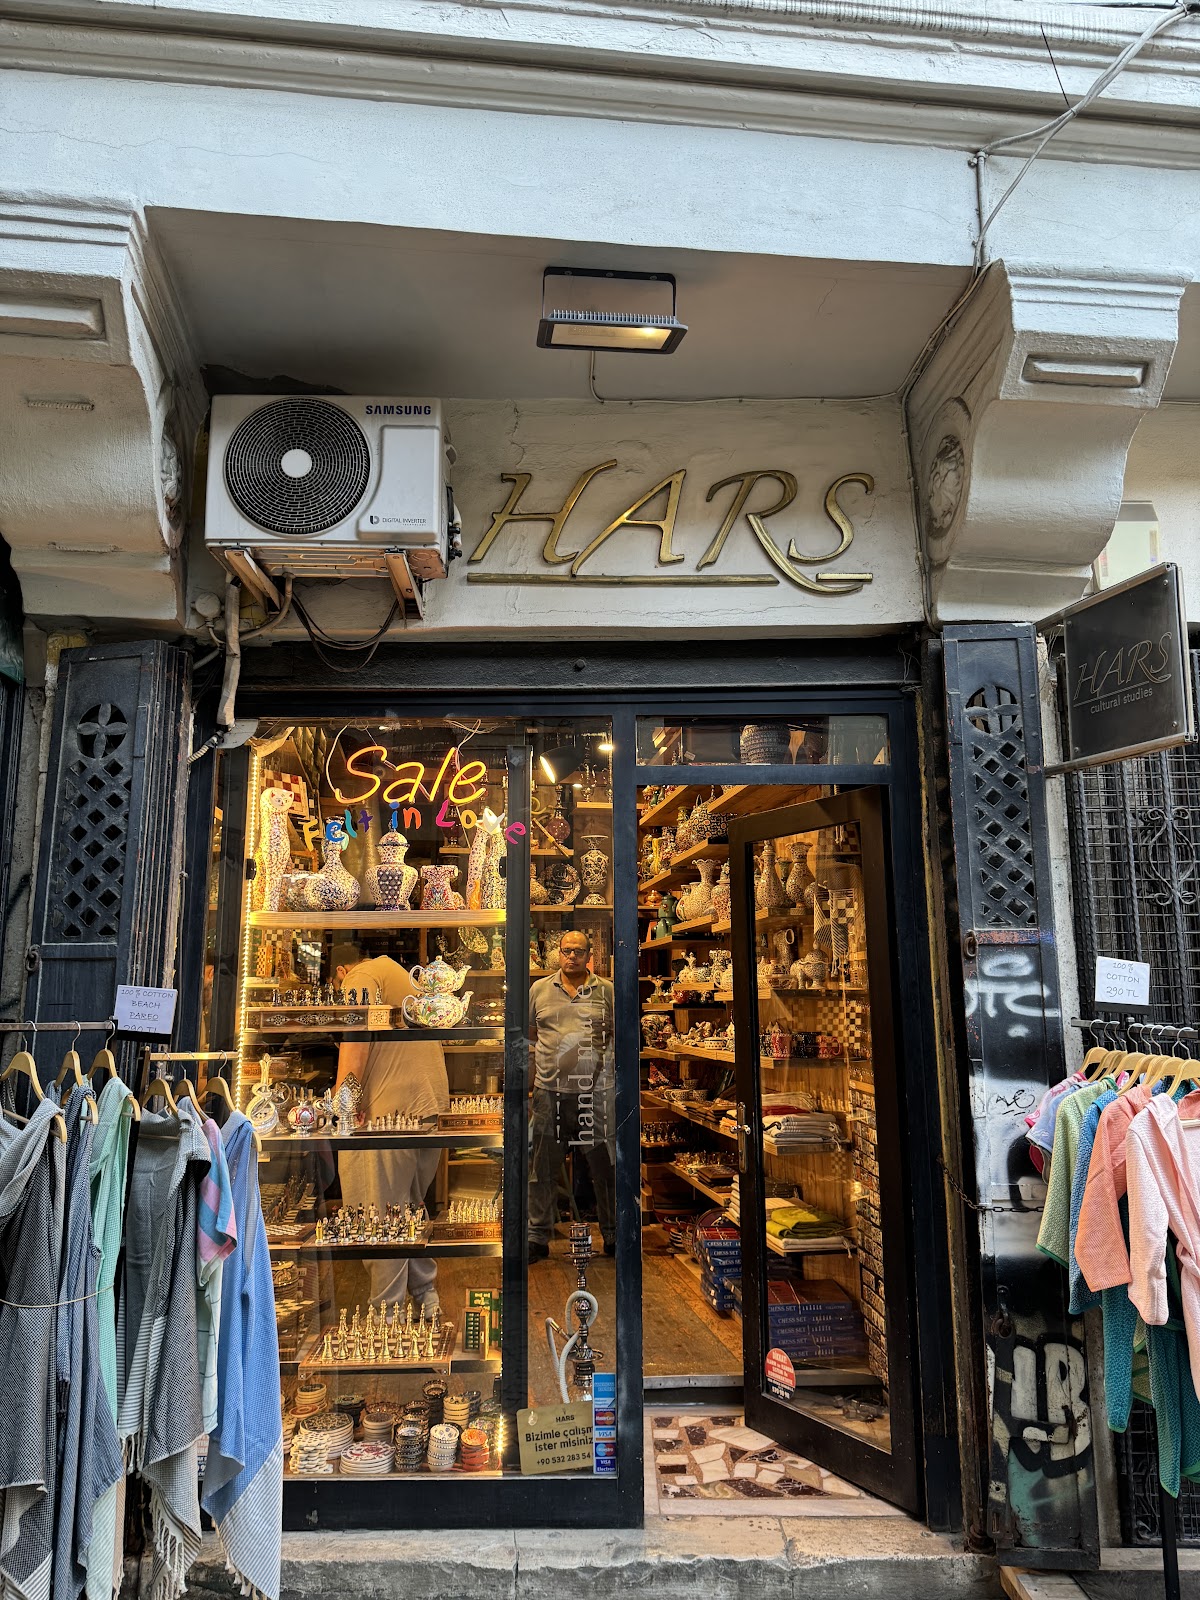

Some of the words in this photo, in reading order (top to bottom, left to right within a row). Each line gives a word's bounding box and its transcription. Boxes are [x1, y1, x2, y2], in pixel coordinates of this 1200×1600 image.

[365, 404, 432, 415] SAMSUNG
[467, 459, 875, 595] HARS
[1073, 631, 1172, 701] HARS
[1090, 695, 1121, 714] cultural
[1123, 687, 1153, 705] studies
[335, 745, 487, 804] Sale
[388, 801, 422, 830] in
[1106, 972, 1140, 984] COTTON
[142, 990, 174, 999] COTTON
[1106, 986, 1124, 998] 290
[1126, 988, 1139, 998] TL
[131, 1000, 161, 1009] BEACH
[568, 1072, 595, 1147] hand
[555, 1415, 575, 1423] HARS
[525, 1429, 561, 1442] Bizimle
[535, 1442, 558, 1452] ister
[537, 1457, 550, 1466] +90
[552, 1455, 566, 1463] 532
[567, 1453, 580, 1462] 283
[581, 1452, 591, 1460] 54
